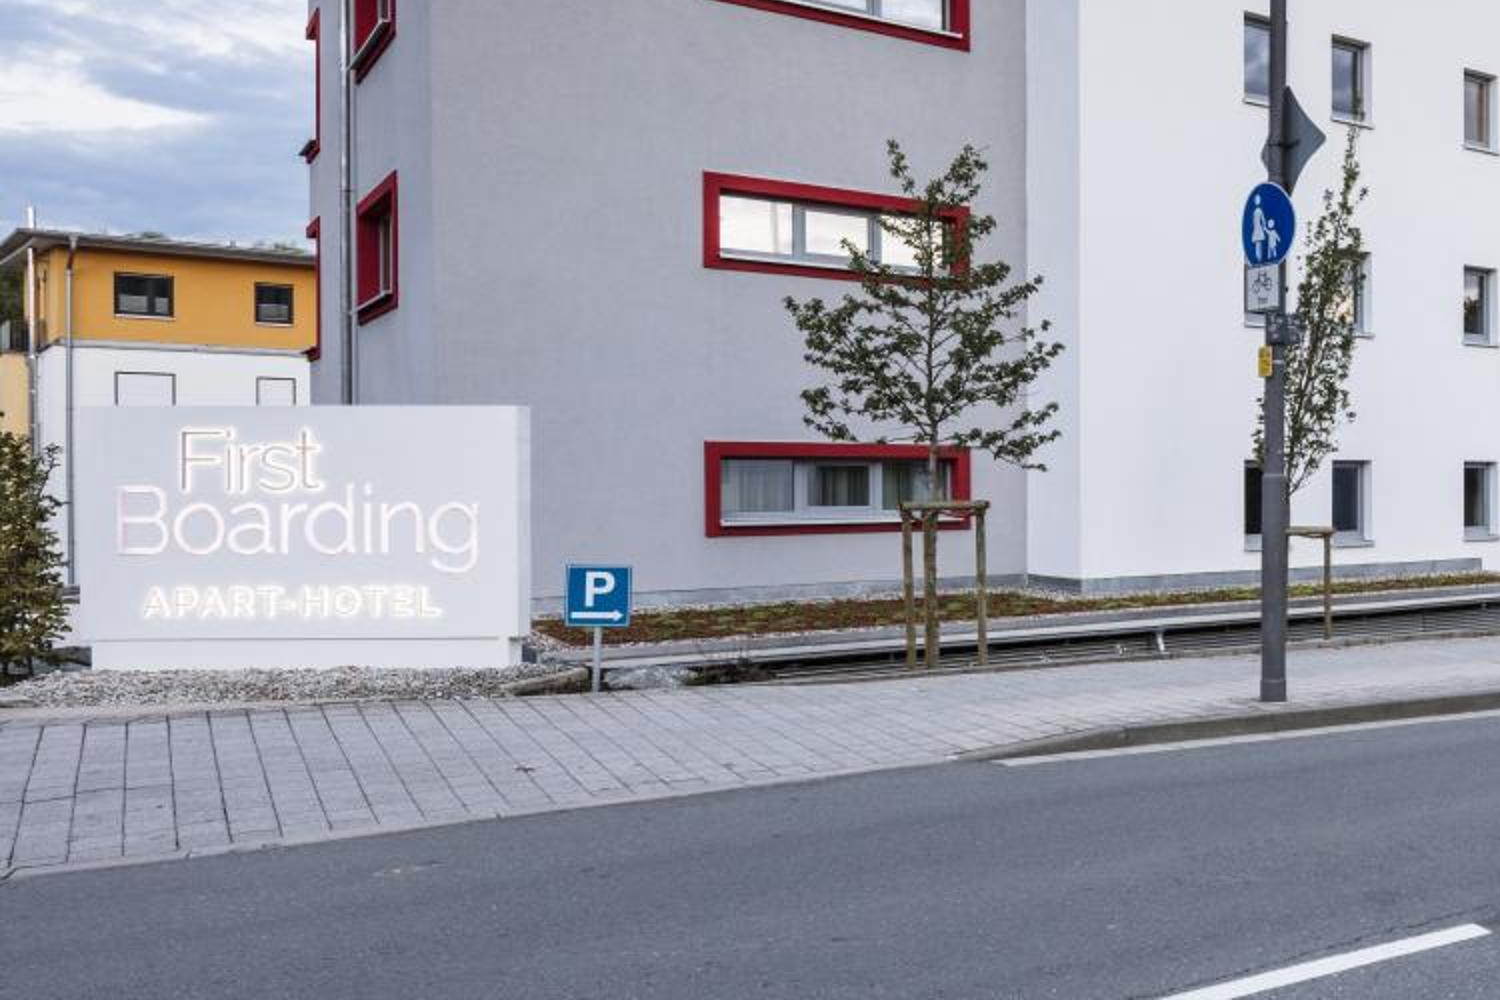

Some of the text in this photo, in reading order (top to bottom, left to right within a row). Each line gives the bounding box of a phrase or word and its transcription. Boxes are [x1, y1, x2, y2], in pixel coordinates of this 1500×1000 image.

[178, 427, 324, 493] First
[116, 484, 480, 573] Boarding
[143, 585, 445, 619] APART-HOTEL
[585, 571, 615, 607] P
